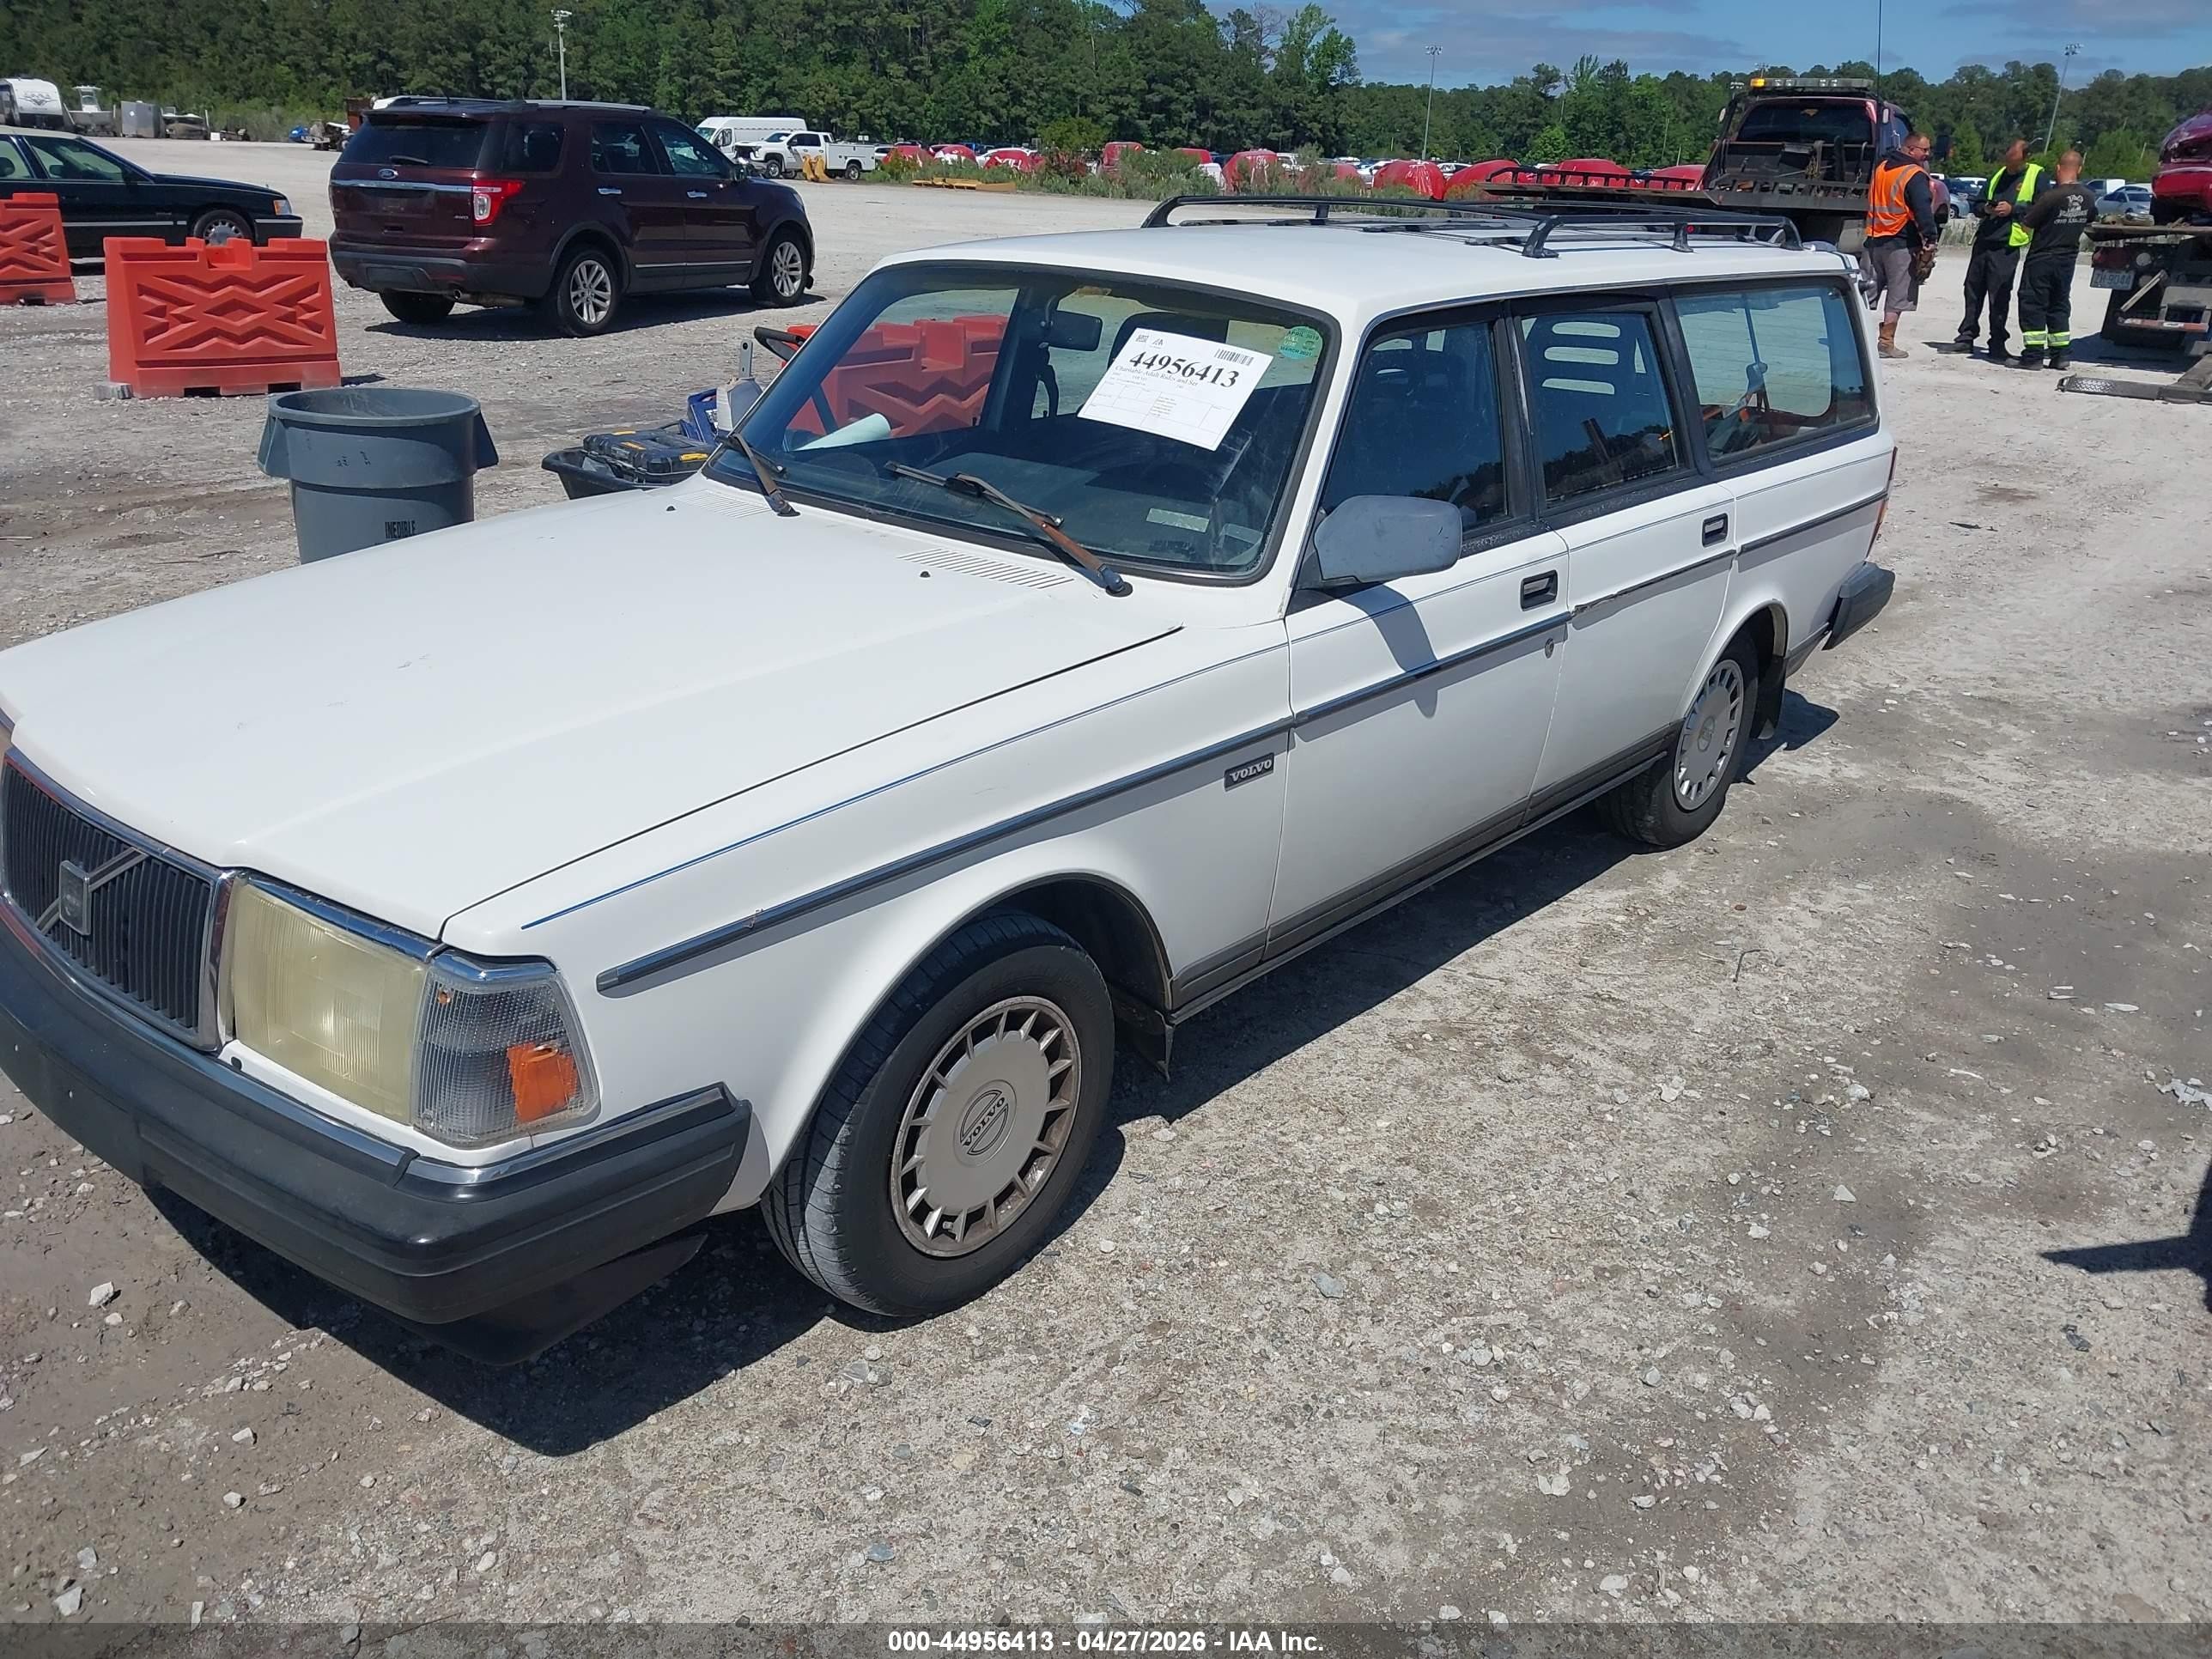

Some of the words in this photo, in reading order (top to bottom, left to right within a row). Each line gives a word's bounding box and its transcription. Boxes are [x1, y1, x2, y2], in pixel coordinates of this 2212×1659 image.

[1129, 351, 1239, 387] 44956413
[1230, 759, 1272, 781] VOLVO
[962, 1097, 1005, 1146] VOLVO
